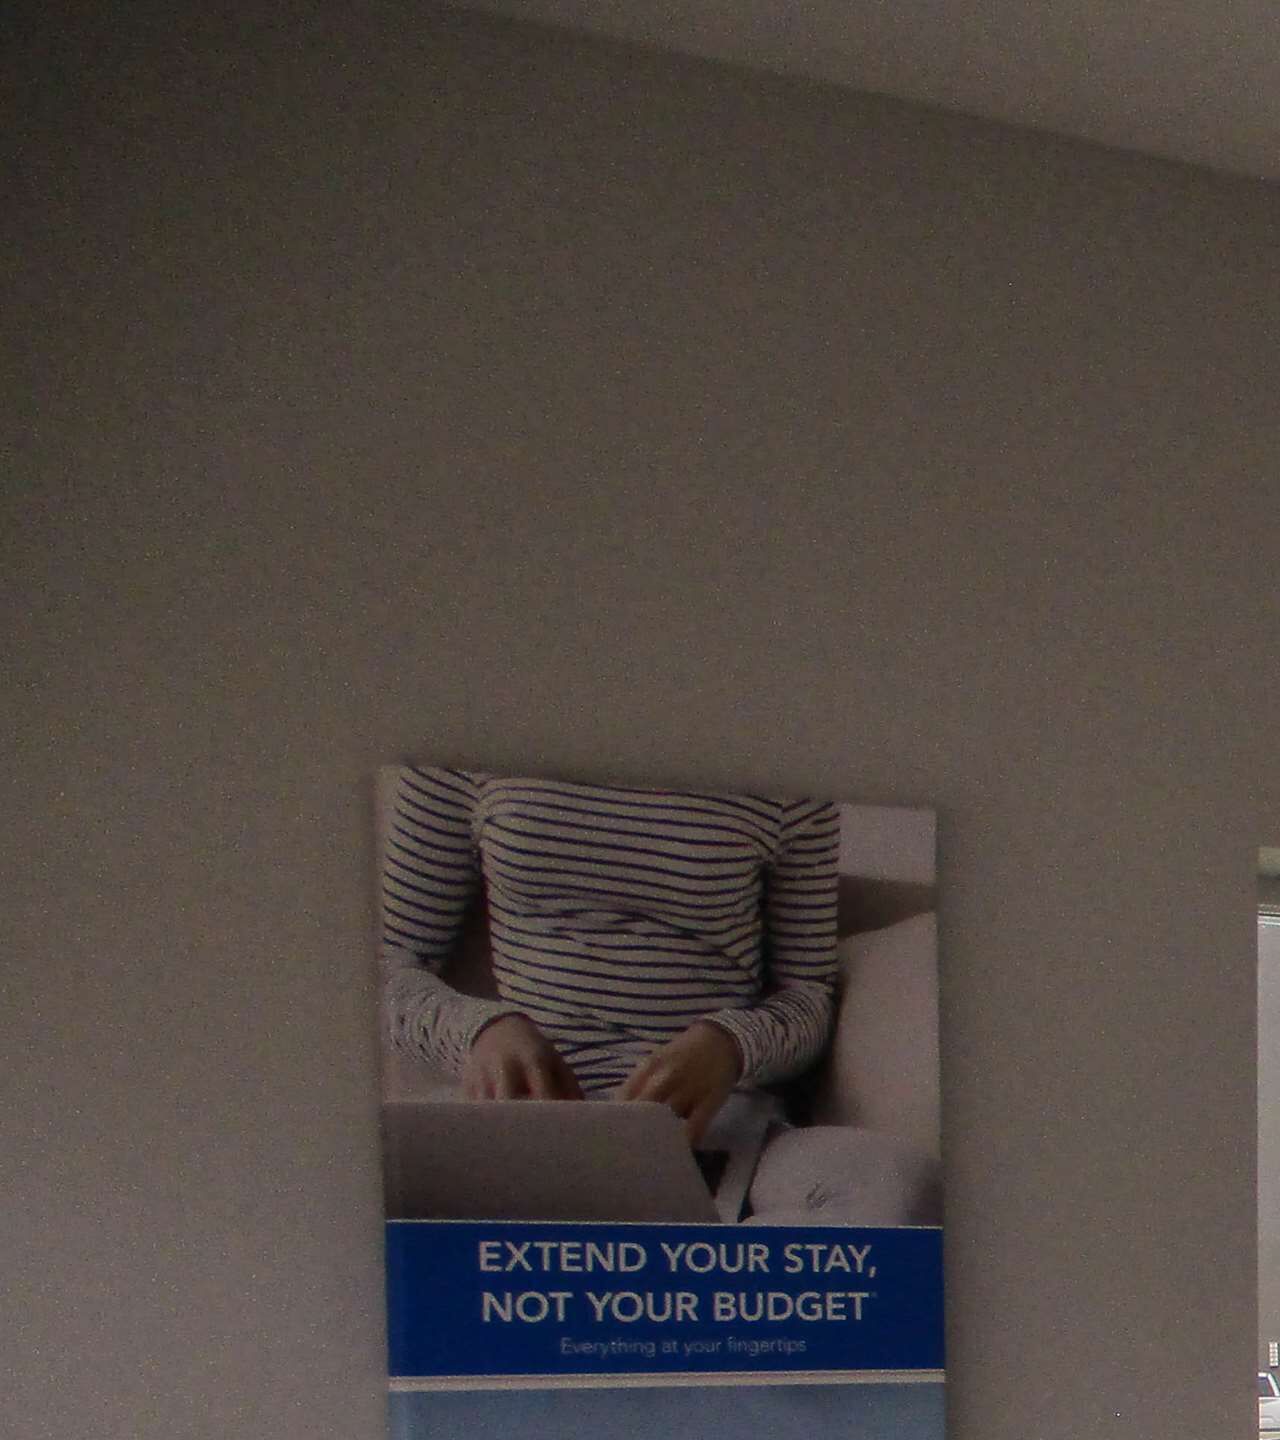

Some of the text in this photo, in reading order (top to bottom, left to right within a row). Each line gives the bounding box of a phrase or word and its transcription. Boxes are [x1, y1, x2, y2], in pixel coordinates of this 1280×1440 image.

[478, 1240, 877, 1279] EXTEND YOUR STAY,
[481, 1291, 869, 1323] NOT YOUR BUDGET
[560, 1335, 807, 1358] Everything at your fingertips
